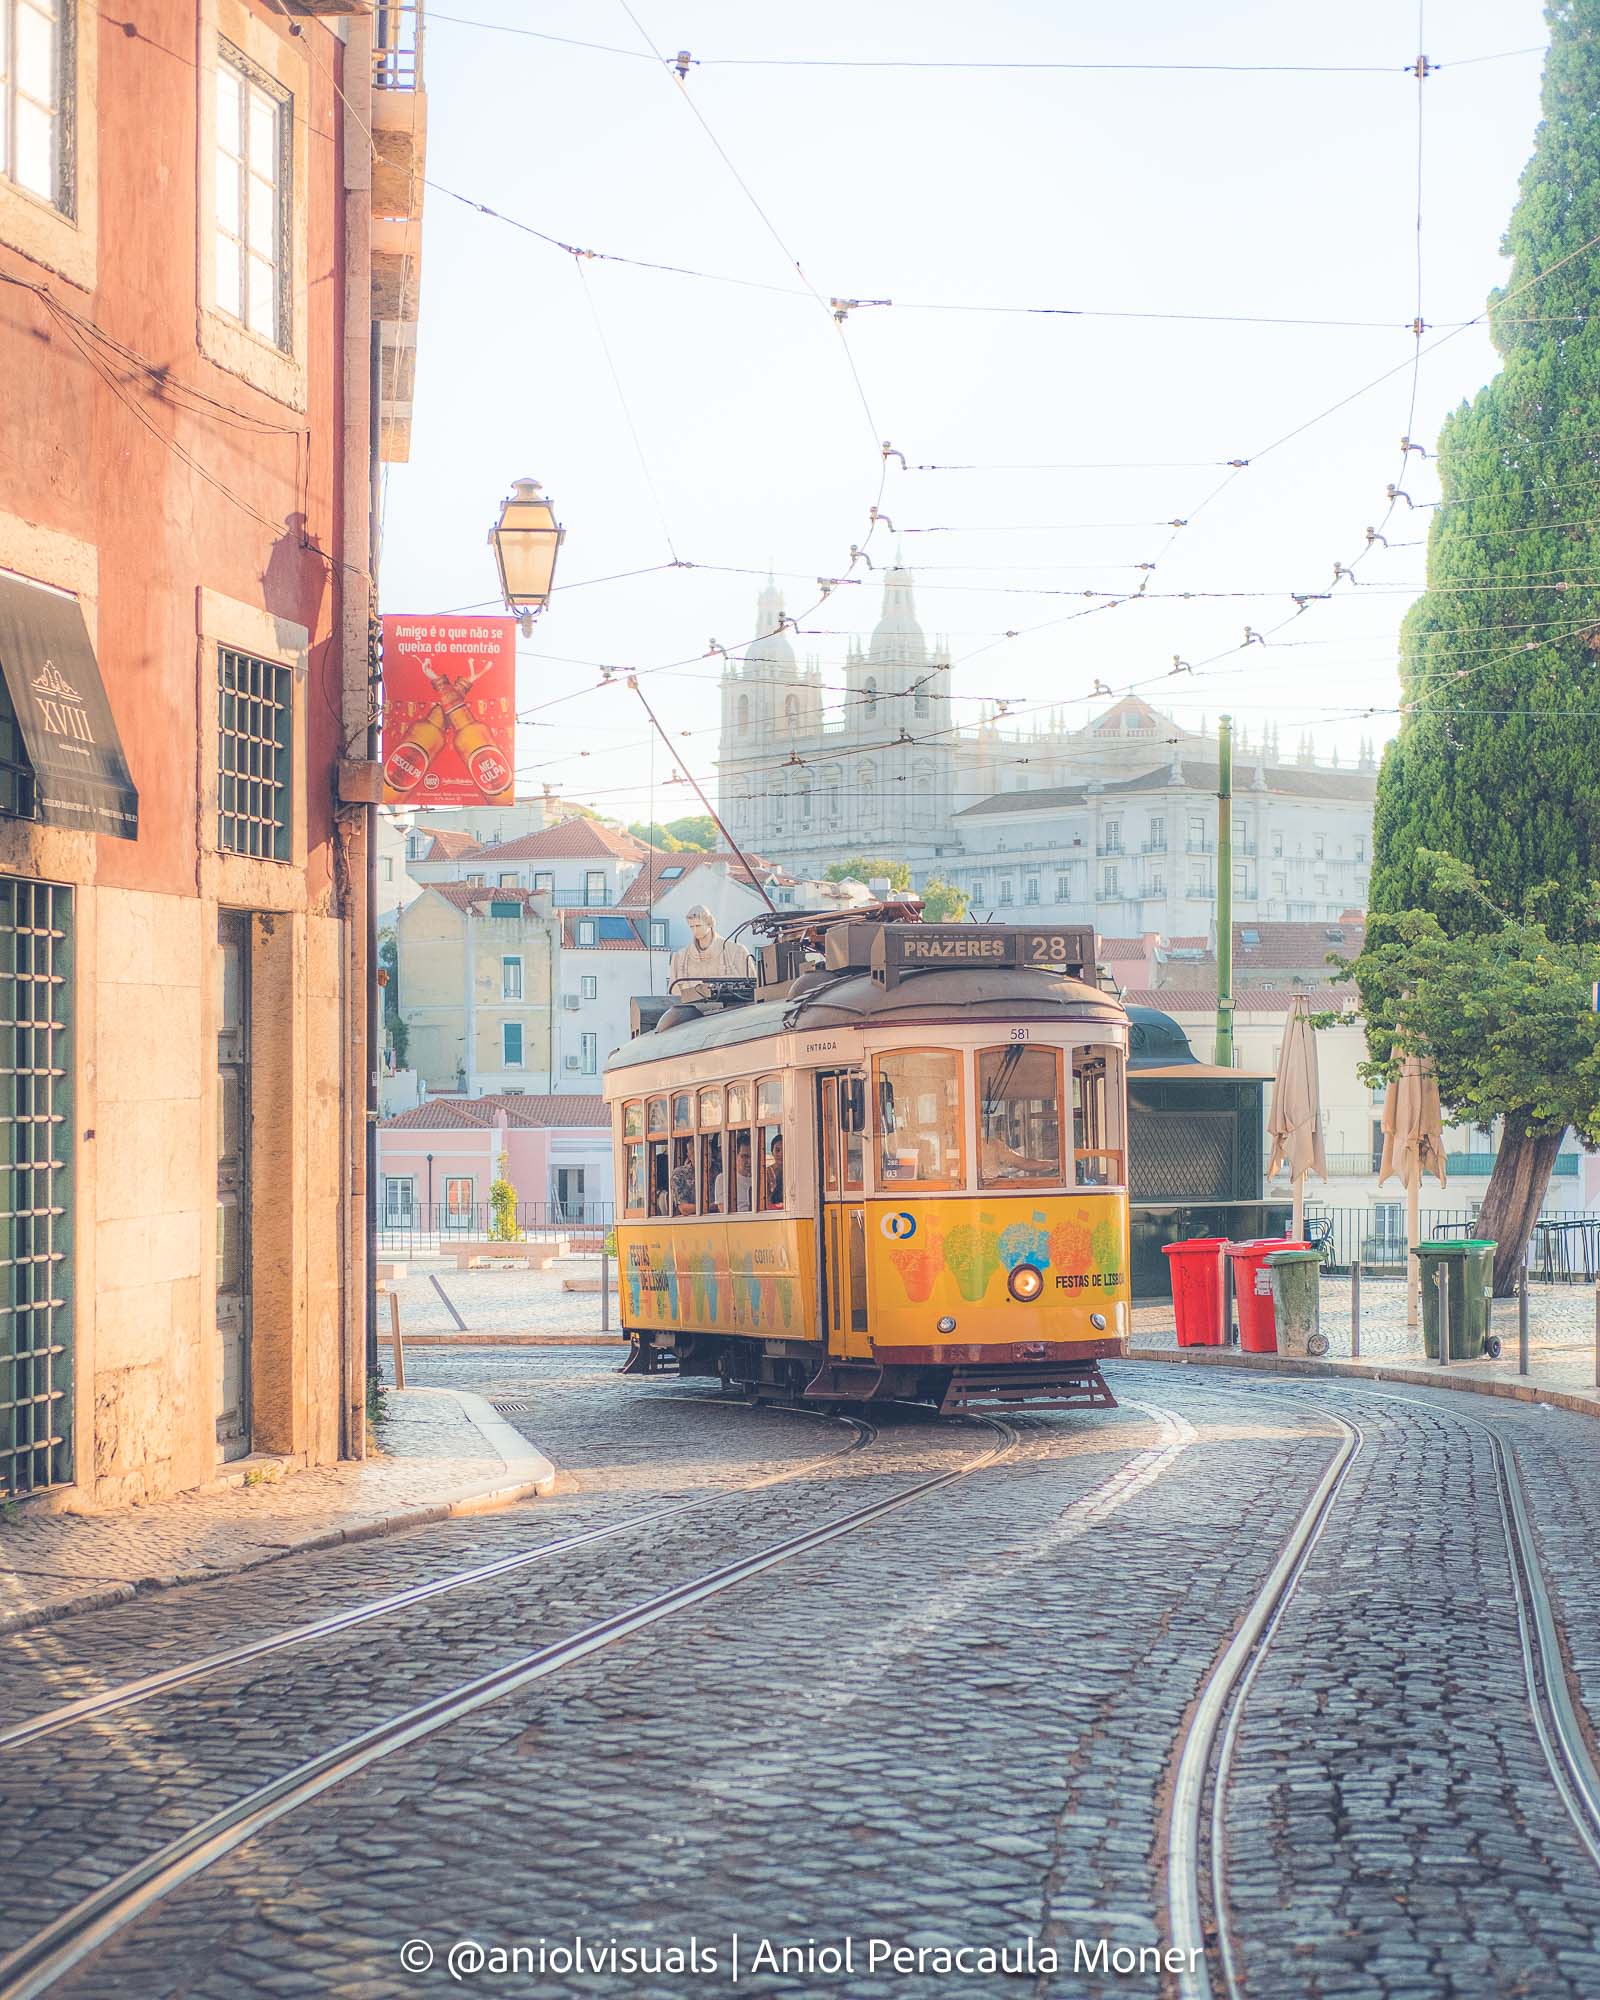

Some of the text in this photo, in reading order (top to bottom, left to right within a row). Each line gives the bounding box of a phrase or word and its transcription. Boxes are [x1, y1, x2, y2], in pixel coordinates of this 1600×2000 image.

[396, 625, 504, 641] Amigo é o que não se
[398, 641, 501, 655] queixa do encontrão
[37, 698, 97, 744] XVIII
[391, 753, 421, 779] DESCULPA
[478, 758, 497, 773] MEA
[480, 764, 506, 784] CULPA
[903, 935, 1067, 961] PRAZERES 28
[1010, 1028, 1030, 1040] 581
[806, 1041, 838, 1053] ENTRADA
[886, 1169, 898, 1178] 03
[1055, 1274, 1090, 1289] FESTAS
[1092, 1274, 1102, 1288] DE
